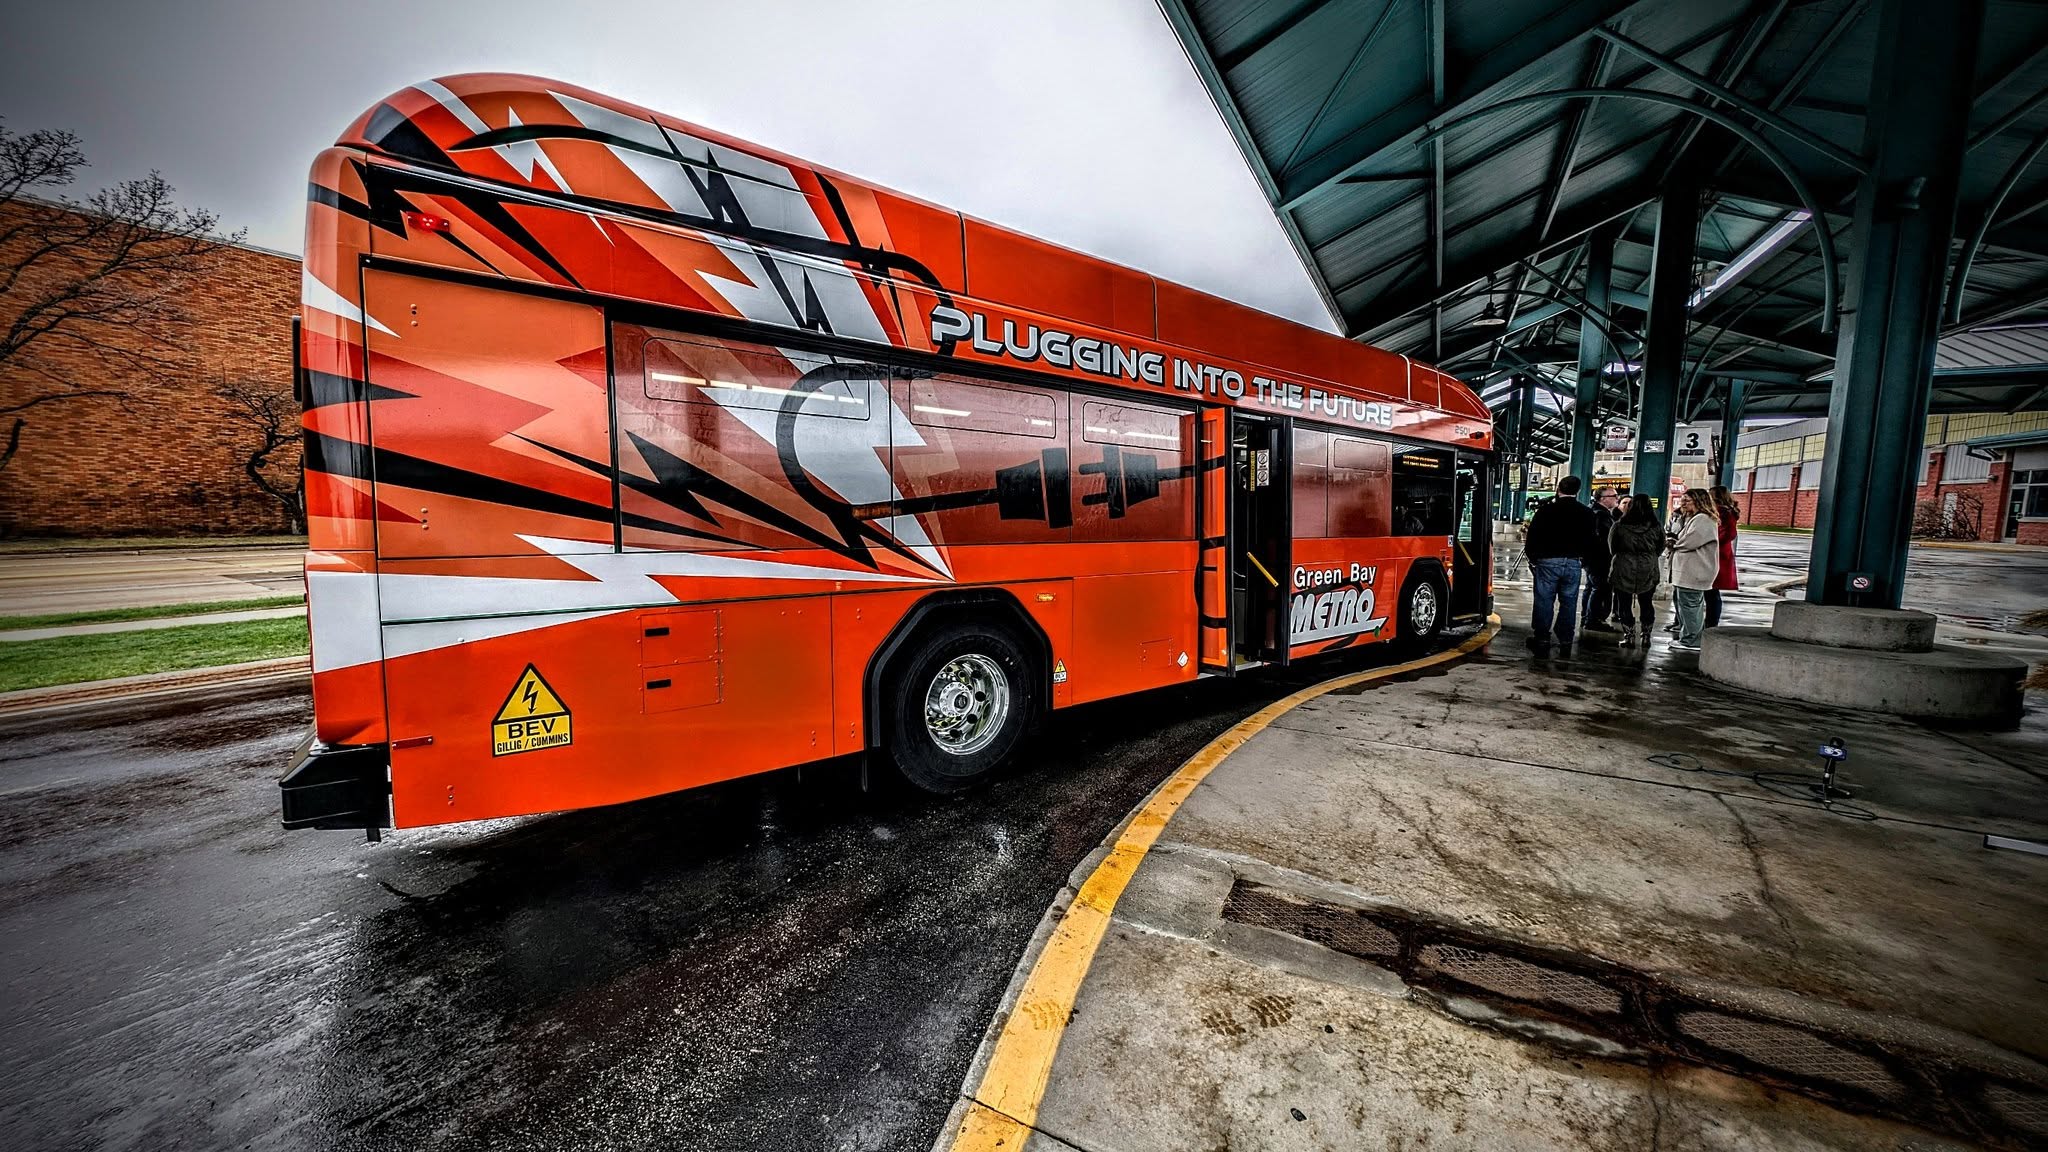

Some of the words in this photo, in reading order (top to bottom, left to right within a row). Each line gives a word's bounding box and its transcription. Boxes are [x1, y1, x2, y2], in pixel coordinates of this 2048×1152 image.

[931, 304, 1164, 384] PLUGGING
[1173, 358, 1245, 398] INTO
[1252, 376, 1304, 409] THE
[1309, 388, 1393, 428] FUTURE
[1685, 432, 1699, 449] 3
[1293, 566, 1342, 588] Green
[1350, 562, 1377, 585] Bay
[1290, 588, 1376, 636] METRO
[508, 718, 556, 739] BEV
[497, 741, 522, 752] GILLIG
[531, 733, 568, 747] CUMMINS
